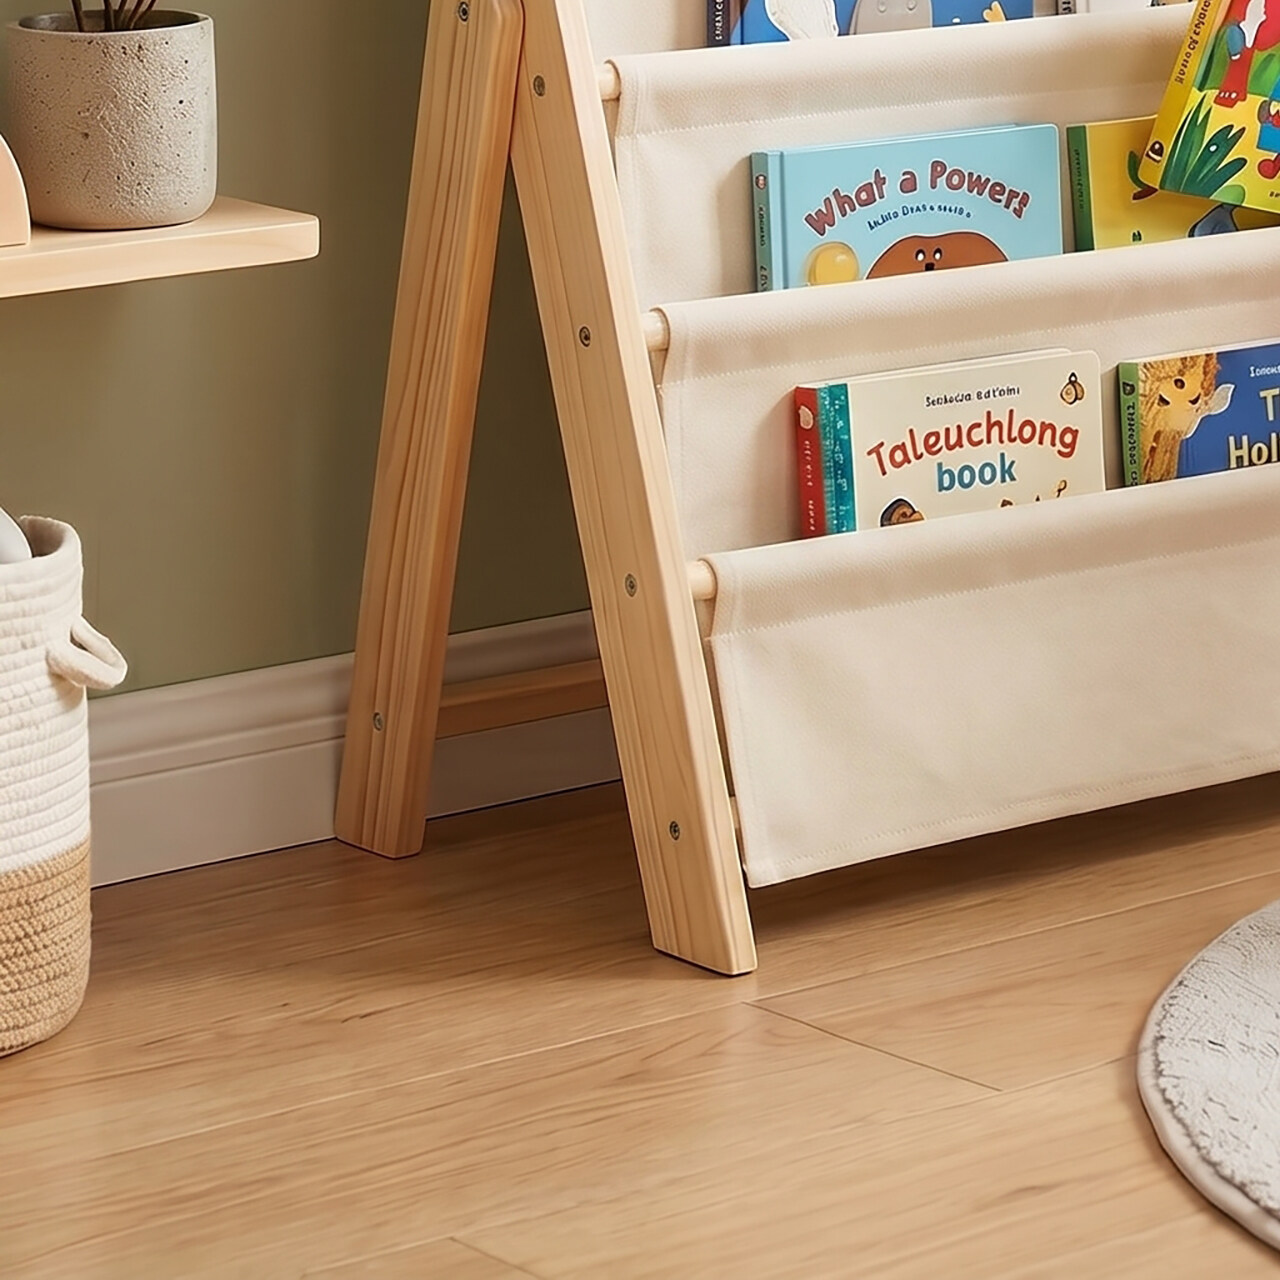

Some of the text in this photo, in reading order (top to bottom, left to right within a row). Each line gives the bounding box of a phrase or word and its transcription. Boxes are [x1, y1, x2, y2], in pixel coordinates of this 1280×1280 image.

[804, 168, 886, 237] What
[899, 171, 918, 194] a
[866, 408, 1080, 477] Taleuchlong
[937, 452, 1017, 493] book
